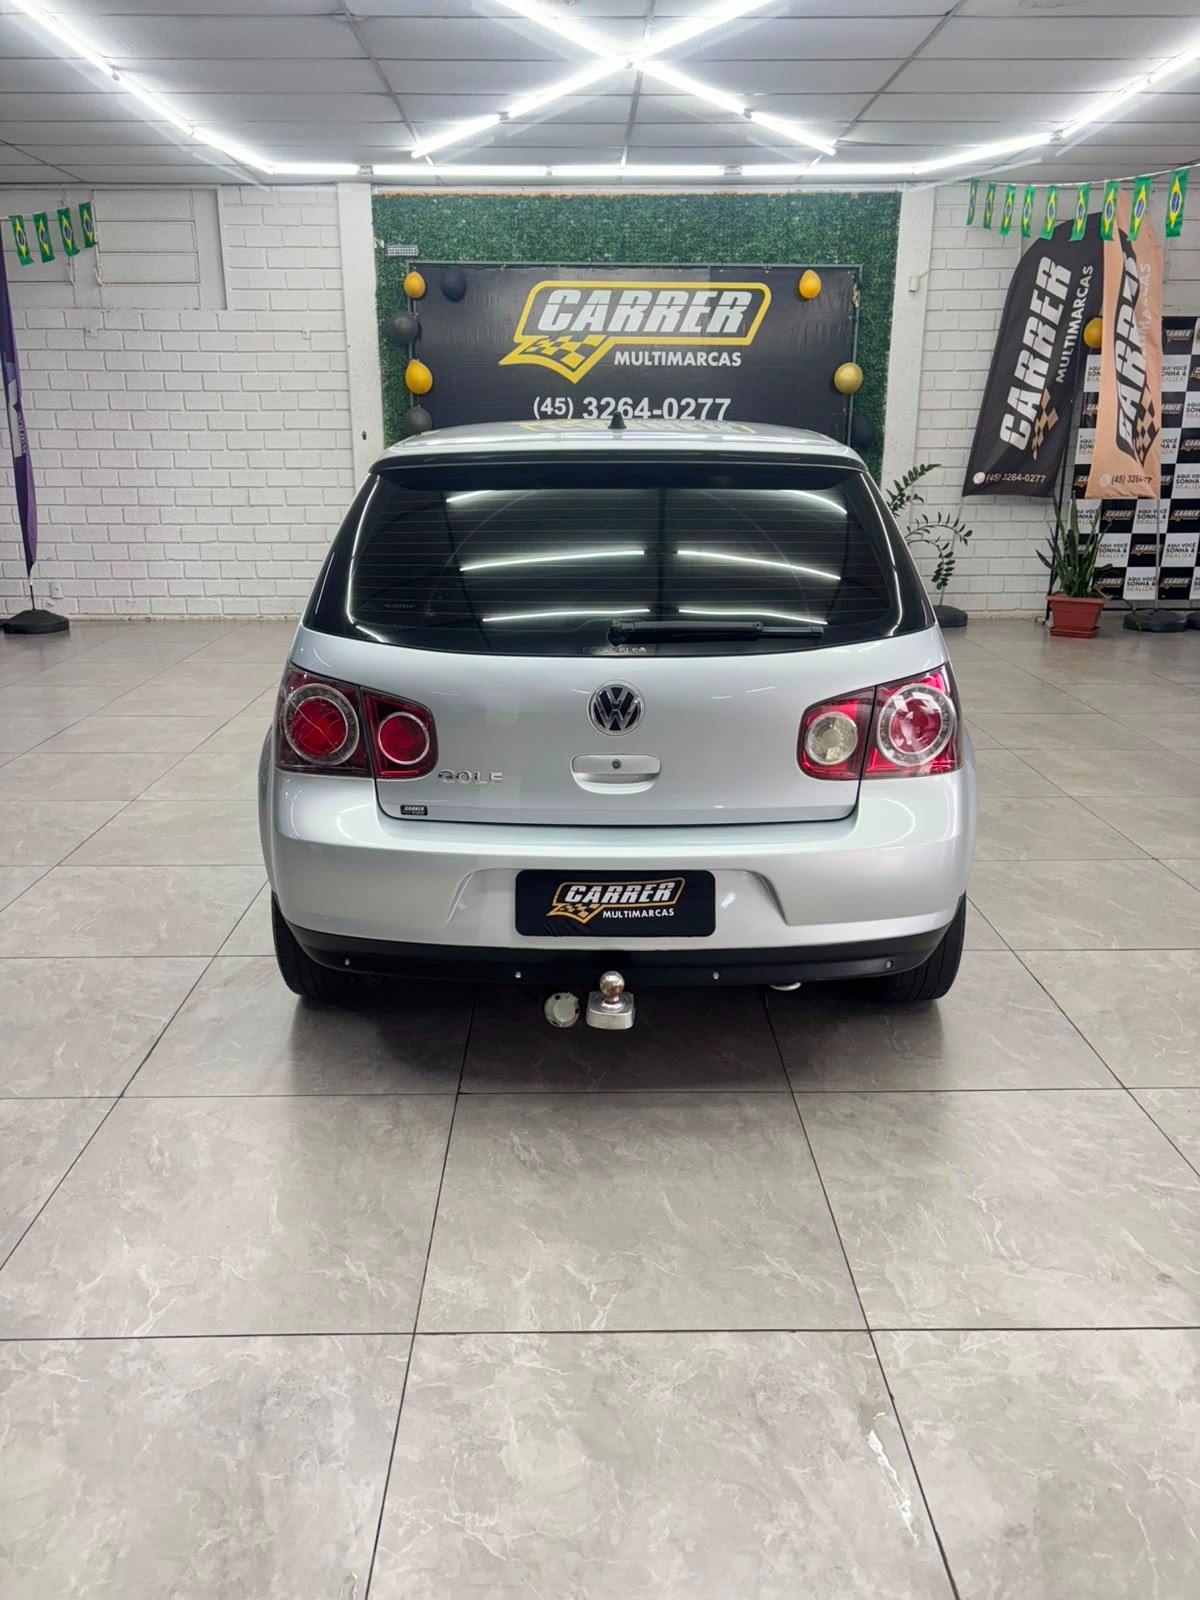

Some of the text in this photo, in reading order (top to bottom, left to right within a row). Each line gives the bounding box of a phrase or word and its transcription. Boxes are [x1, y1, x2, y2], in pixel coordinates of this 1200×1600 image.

[538, 289, 752, 333] CARRER
[1055, 265, 1094, 384] MULTIMARCAS
[614, 351, 741, 366] MULTIMARCAS
[1000, 256, 1072, 450] CARRER
[533, 397, 732, 421] (45) 3264-0277
[986, 473, 1047, 483] (45) 3264-0277
[1111, 475, 1125, 485] (45)
[438, 769, 503, 784] GOLF
[565, 882, 675, 903] CARRER
[603, 908, 675, 918] MULTIMARCAS
